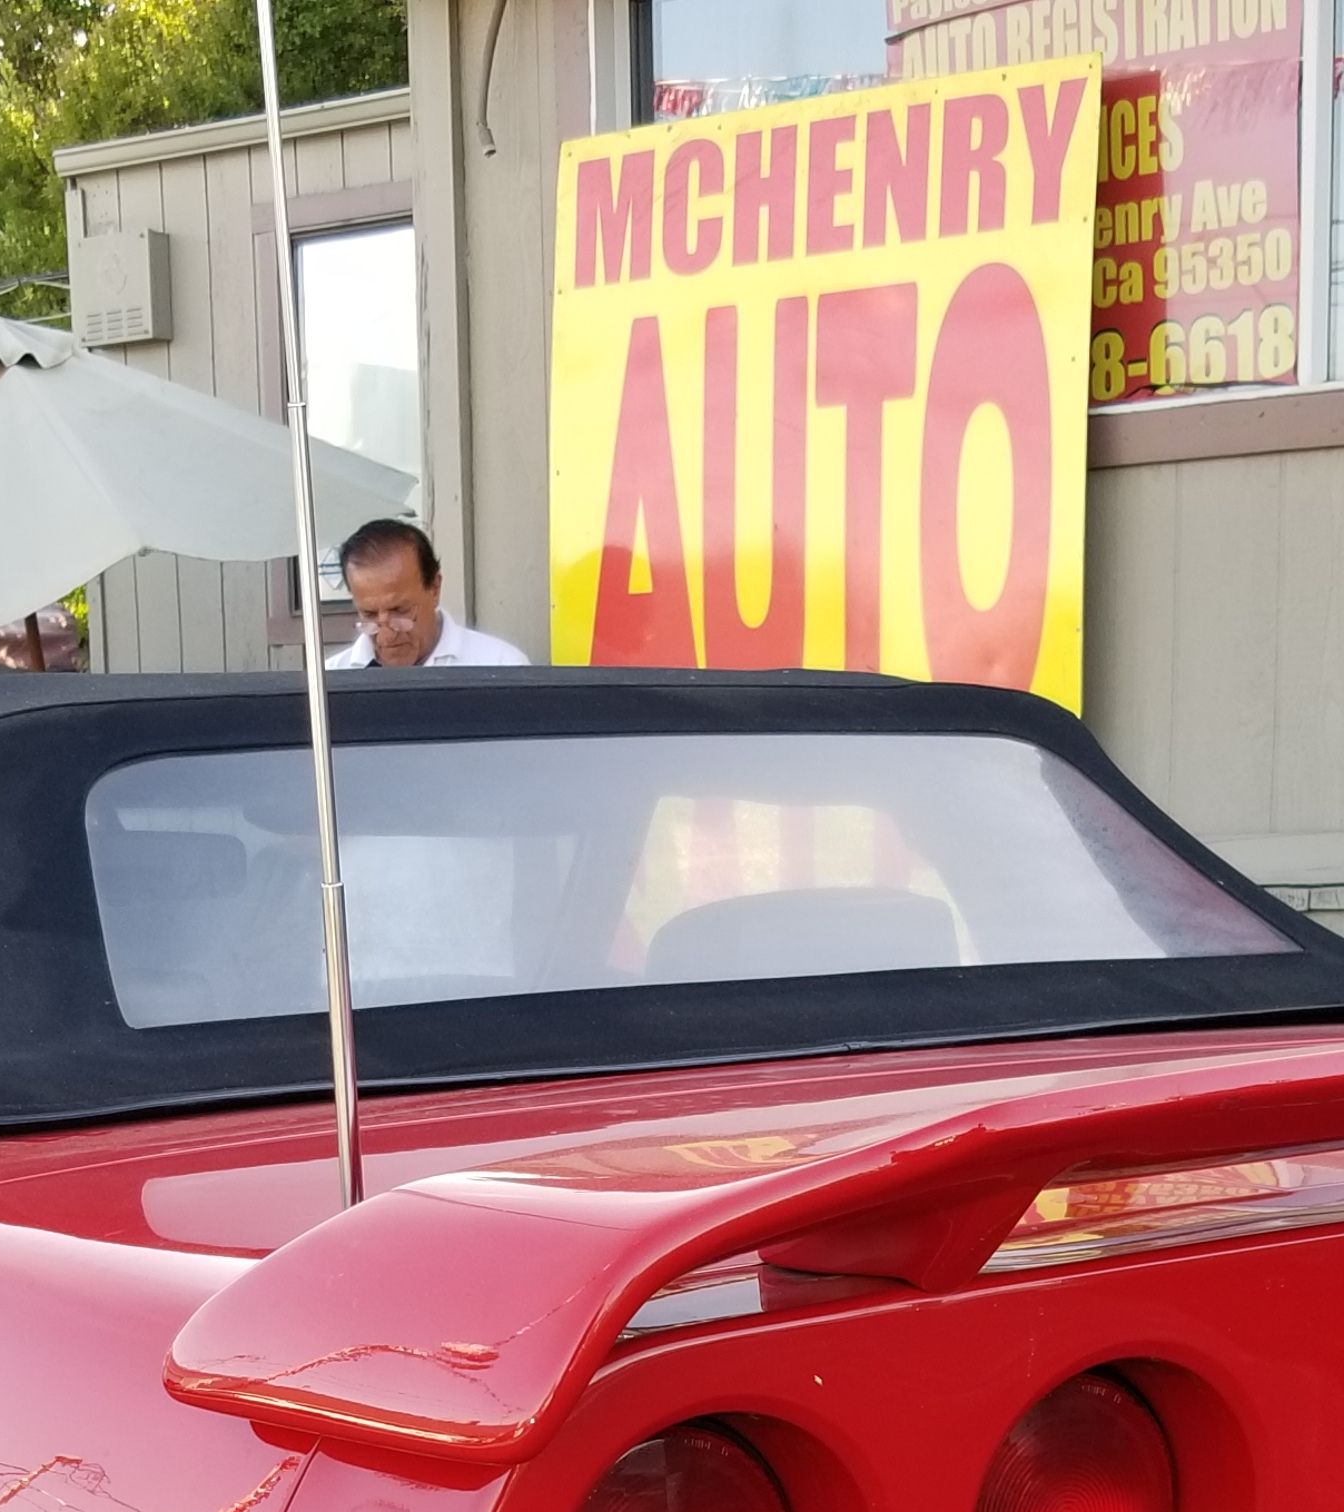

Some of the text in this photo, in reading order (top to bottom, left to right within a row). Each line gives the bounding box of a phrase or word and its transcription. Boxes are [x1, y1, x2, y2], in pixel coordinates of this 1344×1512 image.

[574, 77, 1088, 289] MCHENRY
[1191, 179, 1268, 233] Ave
[1092, 228, 1292, 308] Ca 95350
[1091, 303, 1296, 401] 8-6618
[589, 262, 1052, 693] AUTO
